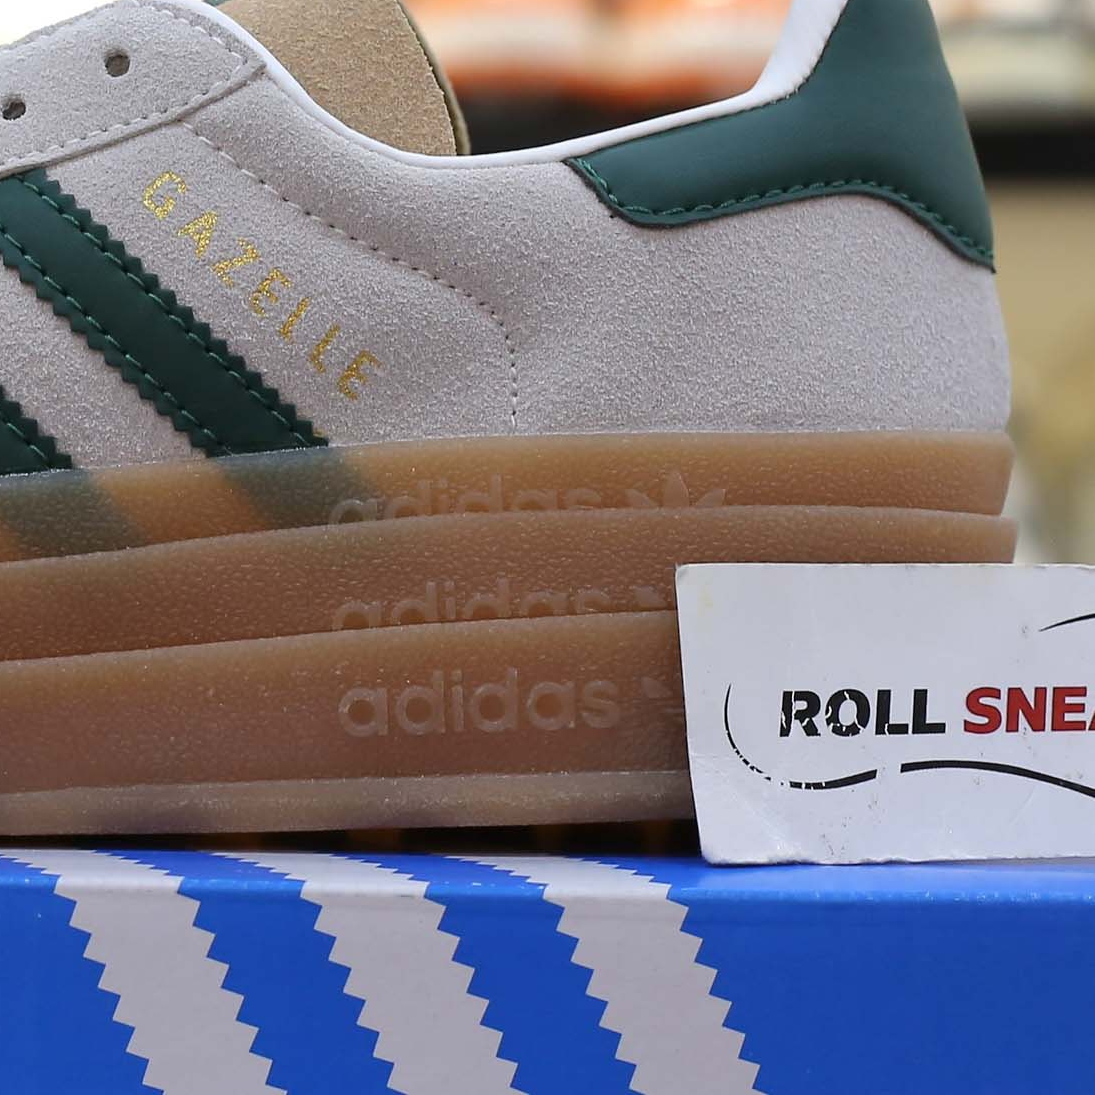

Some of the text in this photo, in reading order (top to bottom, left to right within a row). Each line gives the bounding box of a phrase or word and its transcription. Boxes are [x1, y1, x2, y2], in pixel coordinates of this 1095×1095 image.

[142, 170, 383, 401] GAZELLE
[338, 667, 620, 737] adidas
[779, 686, 1095, 737] ROLL SNE
